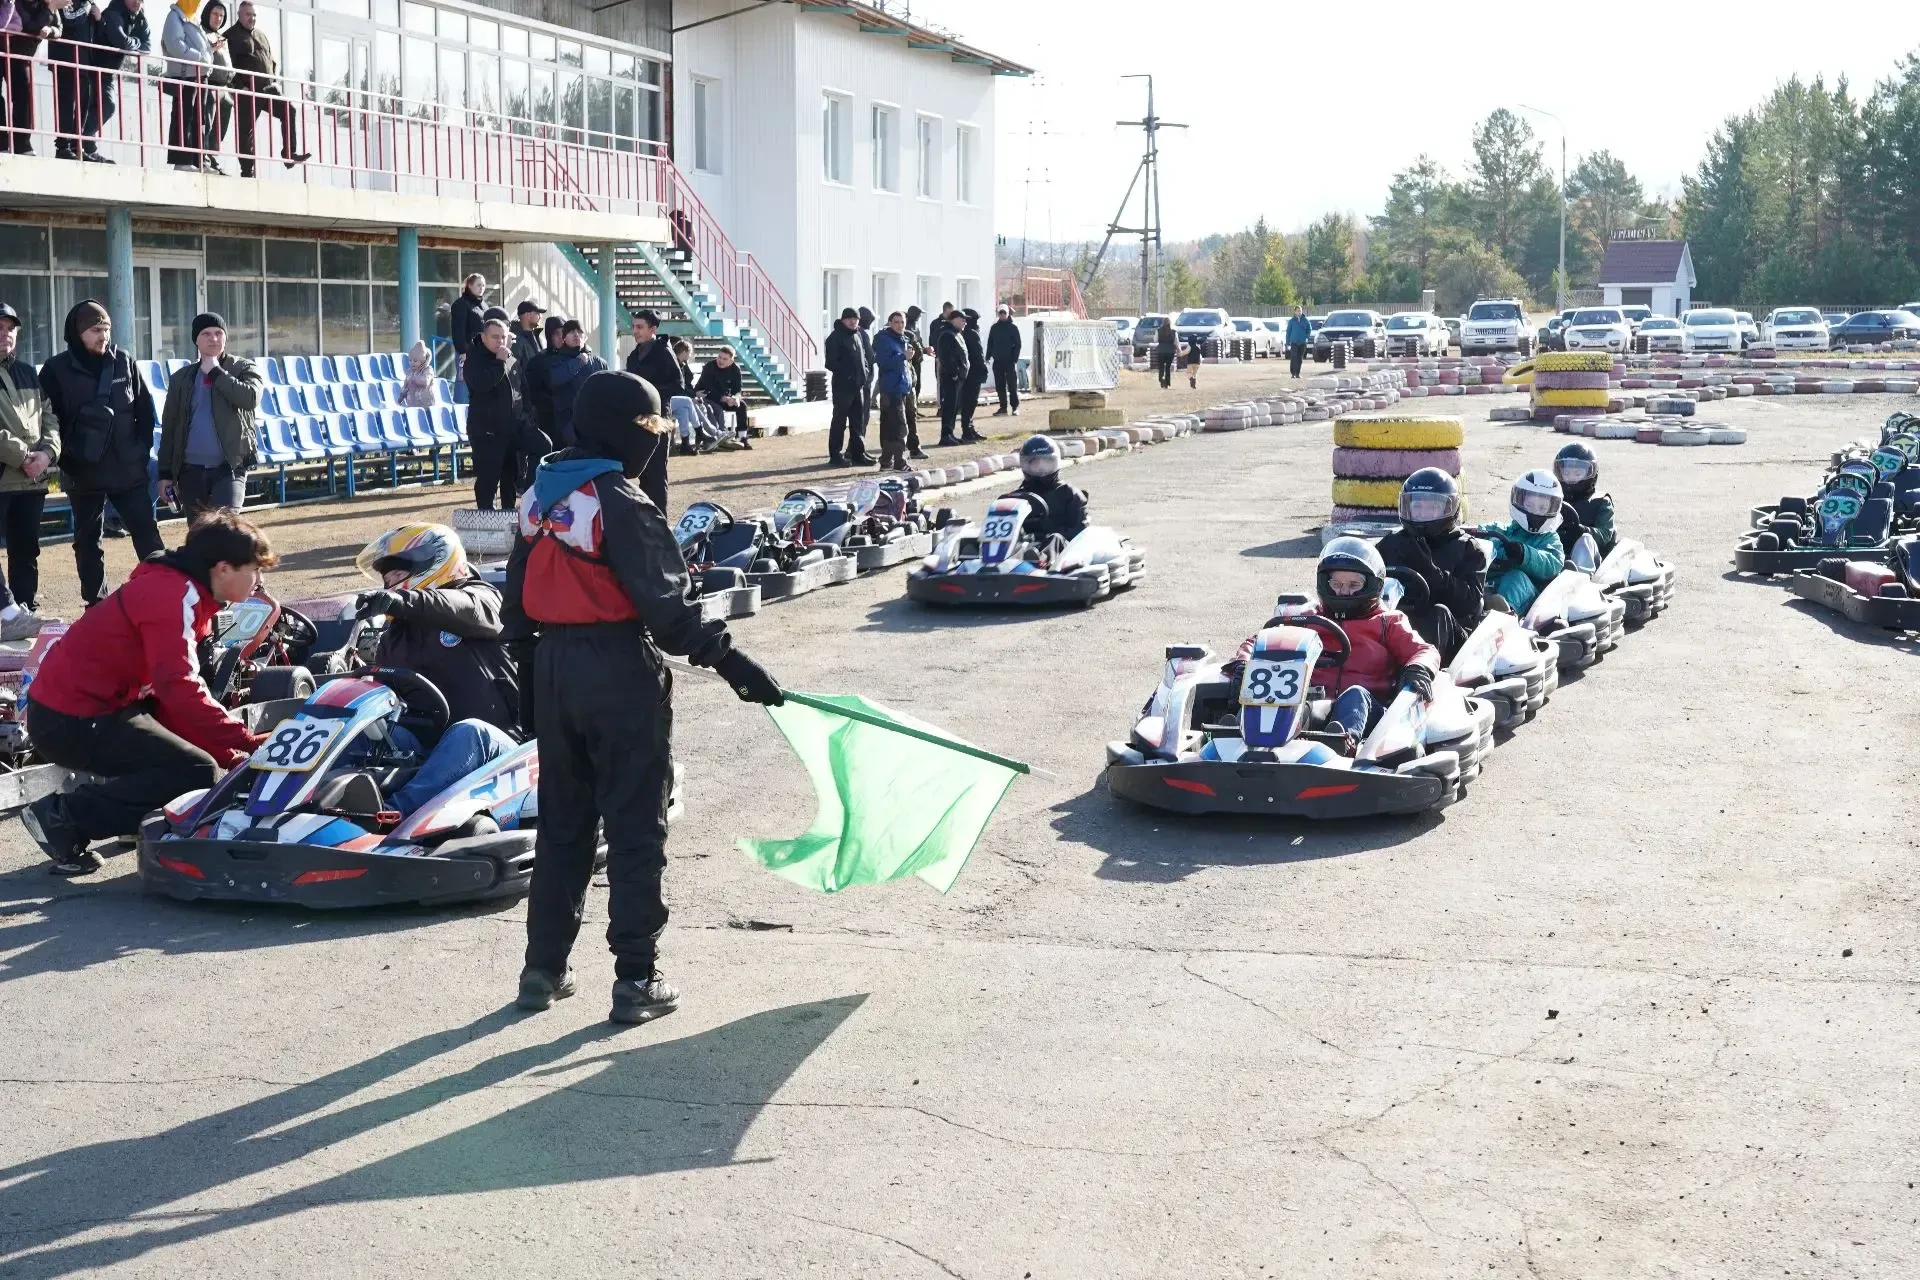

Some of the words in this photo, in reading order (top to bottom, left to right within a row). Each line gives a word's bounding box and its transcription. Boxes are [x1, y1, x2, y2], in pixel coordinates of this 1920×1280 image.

[1054, 350, 1073, 369] PIT
[1873, 454, 1900, 470] 95
[1823, 499, 1857, 515] 93
[679, 514, 710, 530] 63
[984, 520, 1013, 538] 89
[1247, 667, 1300, 700] 83
[264, 727, 330, 764] 86
